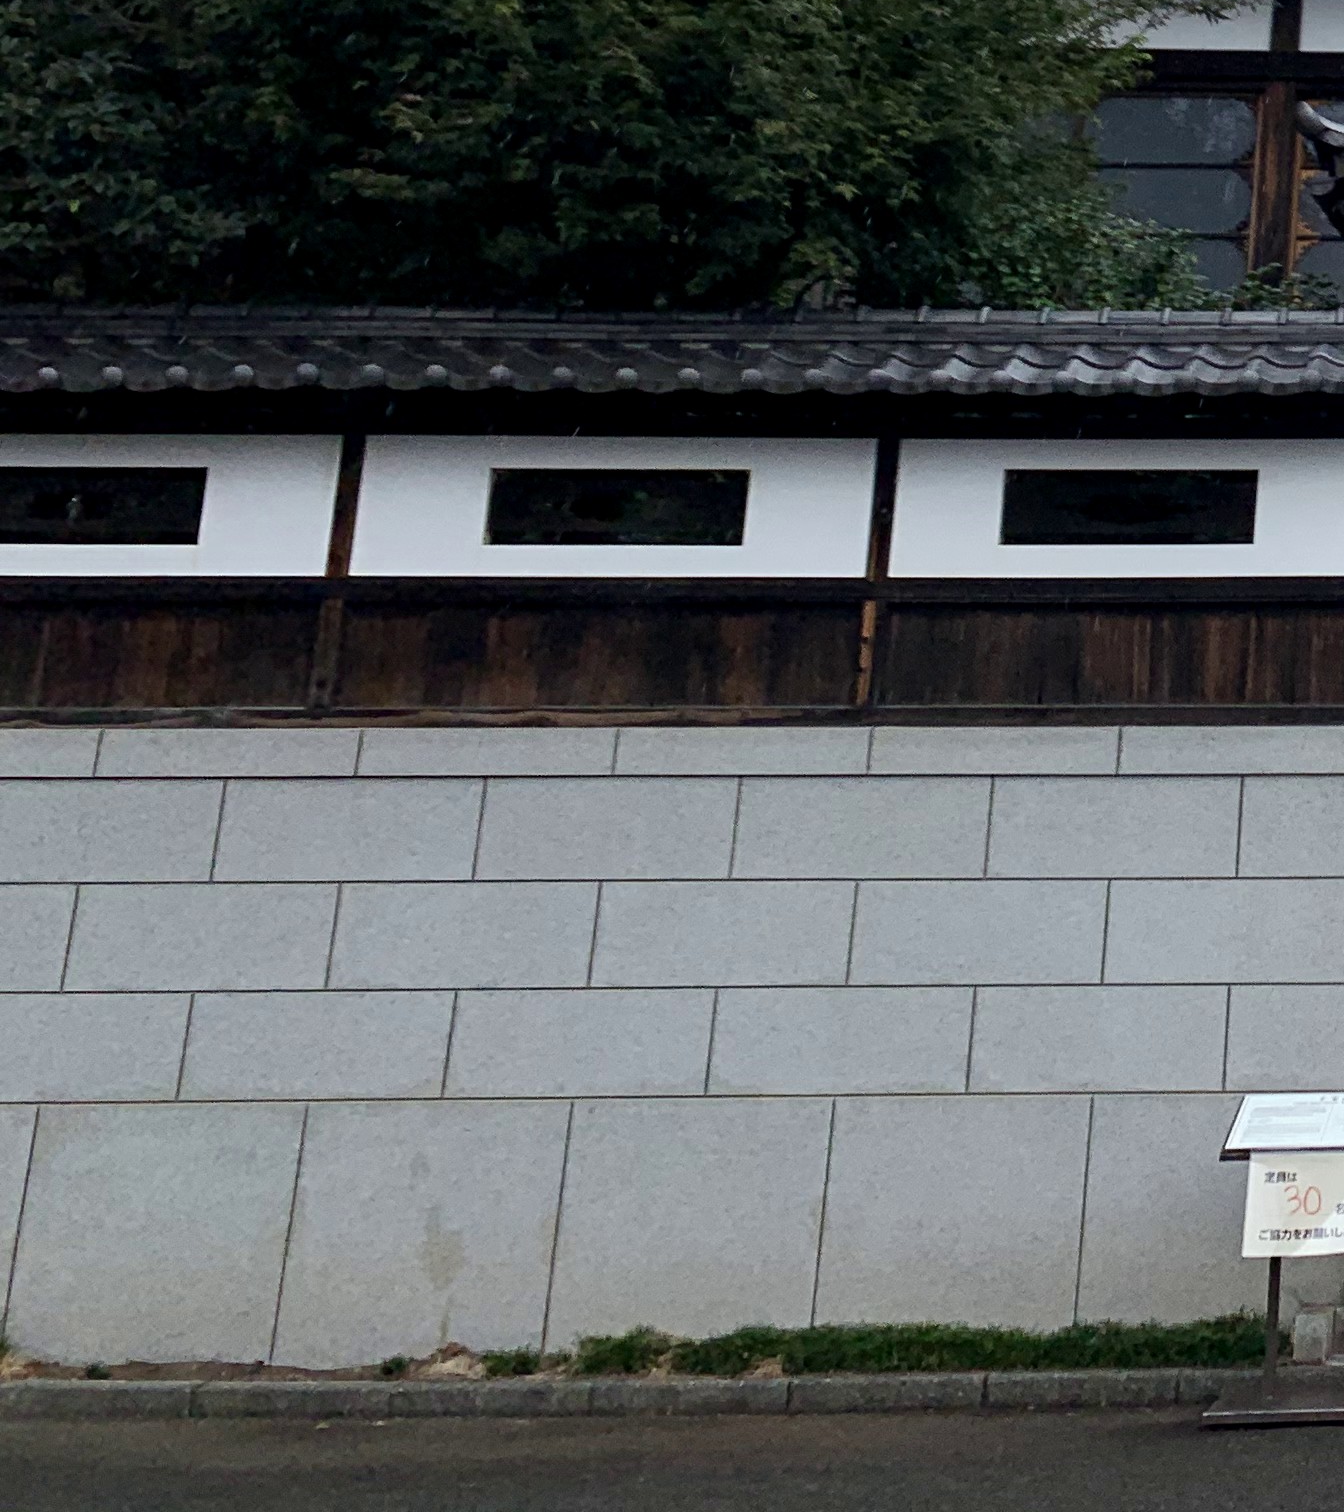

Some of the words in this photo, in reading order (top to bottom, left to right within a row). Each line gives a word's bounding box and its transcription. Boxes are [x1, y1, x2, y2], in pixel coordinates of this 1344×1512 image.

[1265, 1171, 1298, 1183] 定員は
[1284, 1185, 1322, 1215] 30
